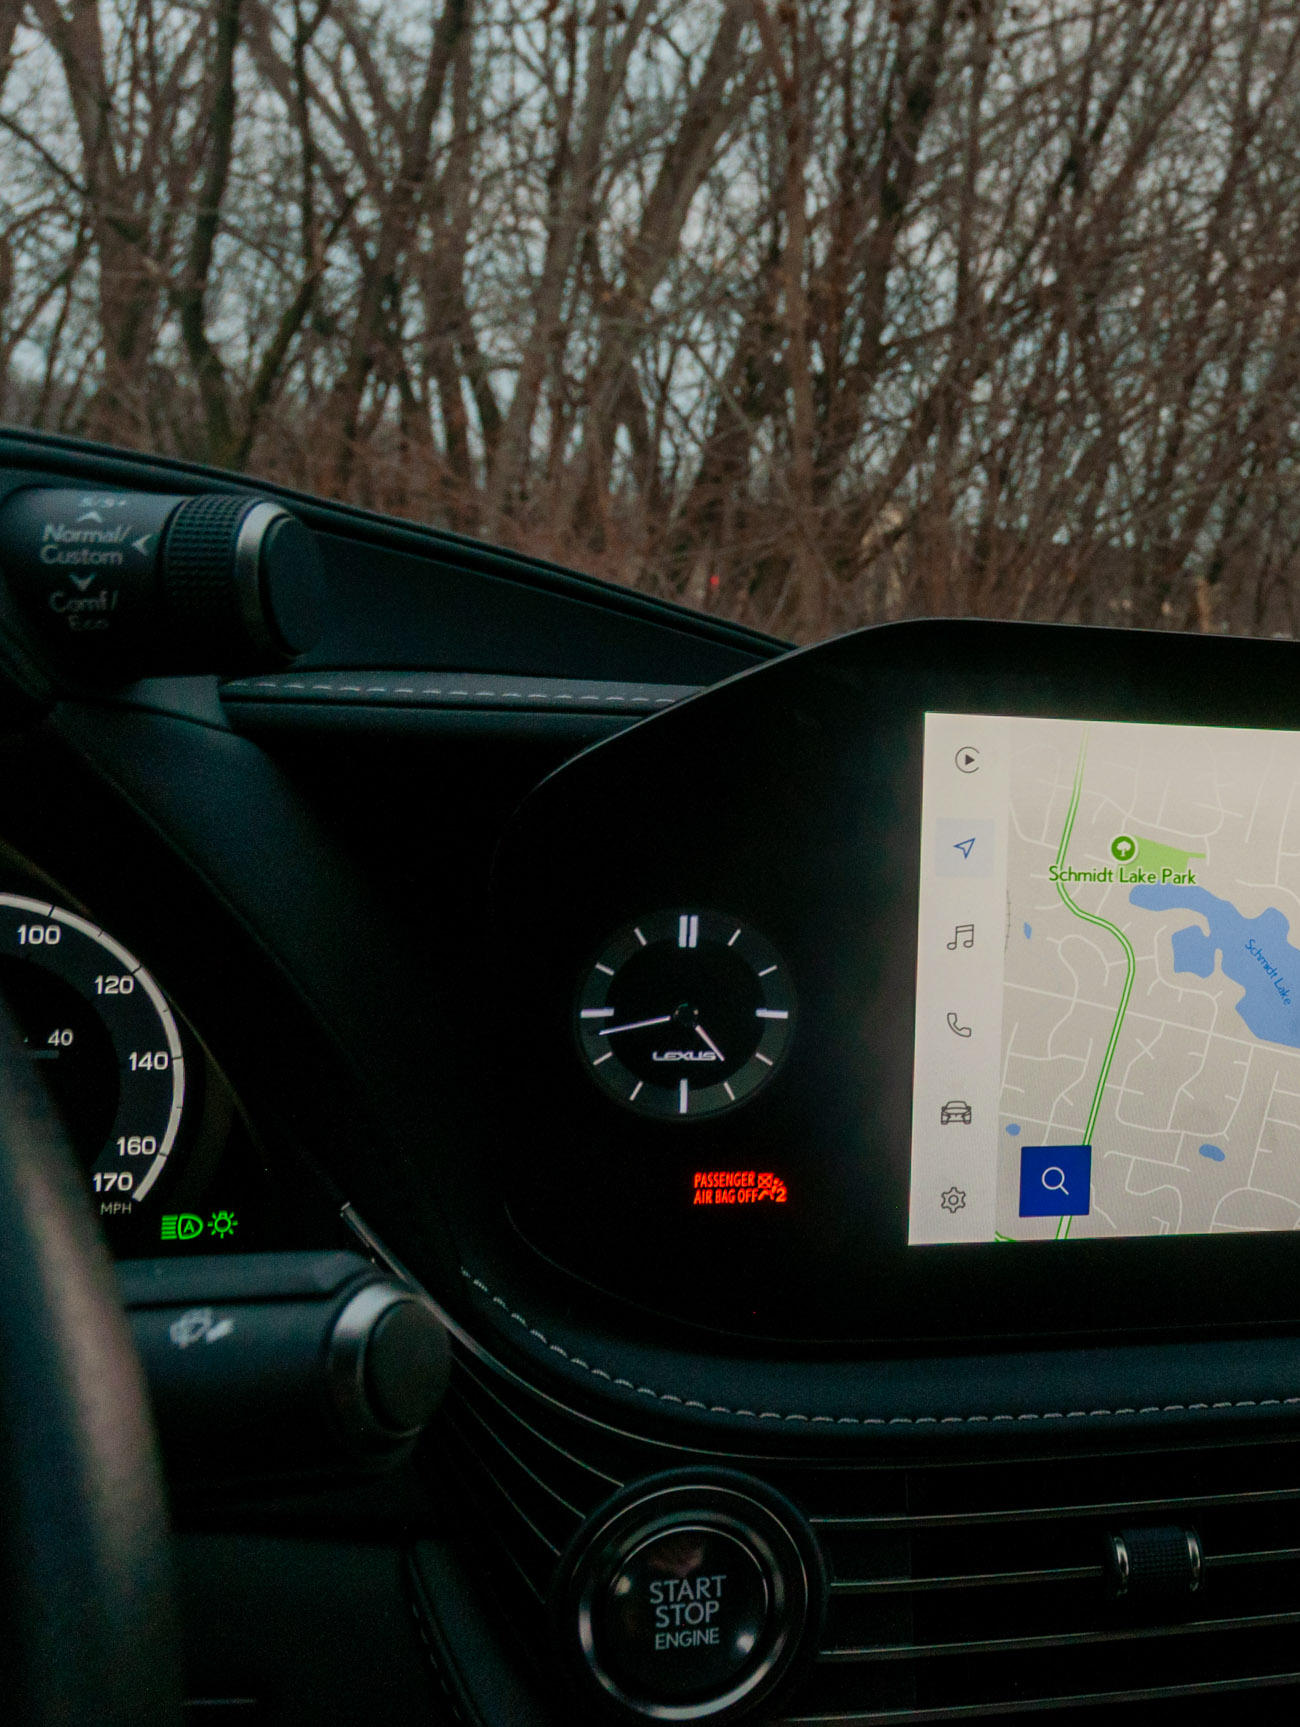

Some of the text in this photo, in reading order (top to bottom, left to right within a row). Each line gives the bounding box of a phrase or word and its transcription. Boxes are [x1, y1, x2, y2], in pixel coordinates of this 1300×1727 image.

[40, 544, 123, 565] Custom
[1049, 865, 1196, 885] Schmidt Lake Park
[17, 924, 61, 945] 100
[1244, 938, 1291, 1006] Schmidt Lake
[94, 975, 134, 995] 120
[47, 1028, 74, 1047] 40
[129, 1051, 169, 1071] 140
[652, 1051, 716, 1062] LEXUS
[116, 1136, 157, 1156] 160
[93, 1172, 134, 1192] 170
[694, 1171, 756, 1188] PASSENGER
[693, 1187, 758, 1204] AIR BAG OFF
[101, 1203, 132, 1215] MPH
[650, 1575, 726, 1604] START
[655, 1600, 720, 1628] STOP
[655, 1627, 720, 1649] ENGINE
